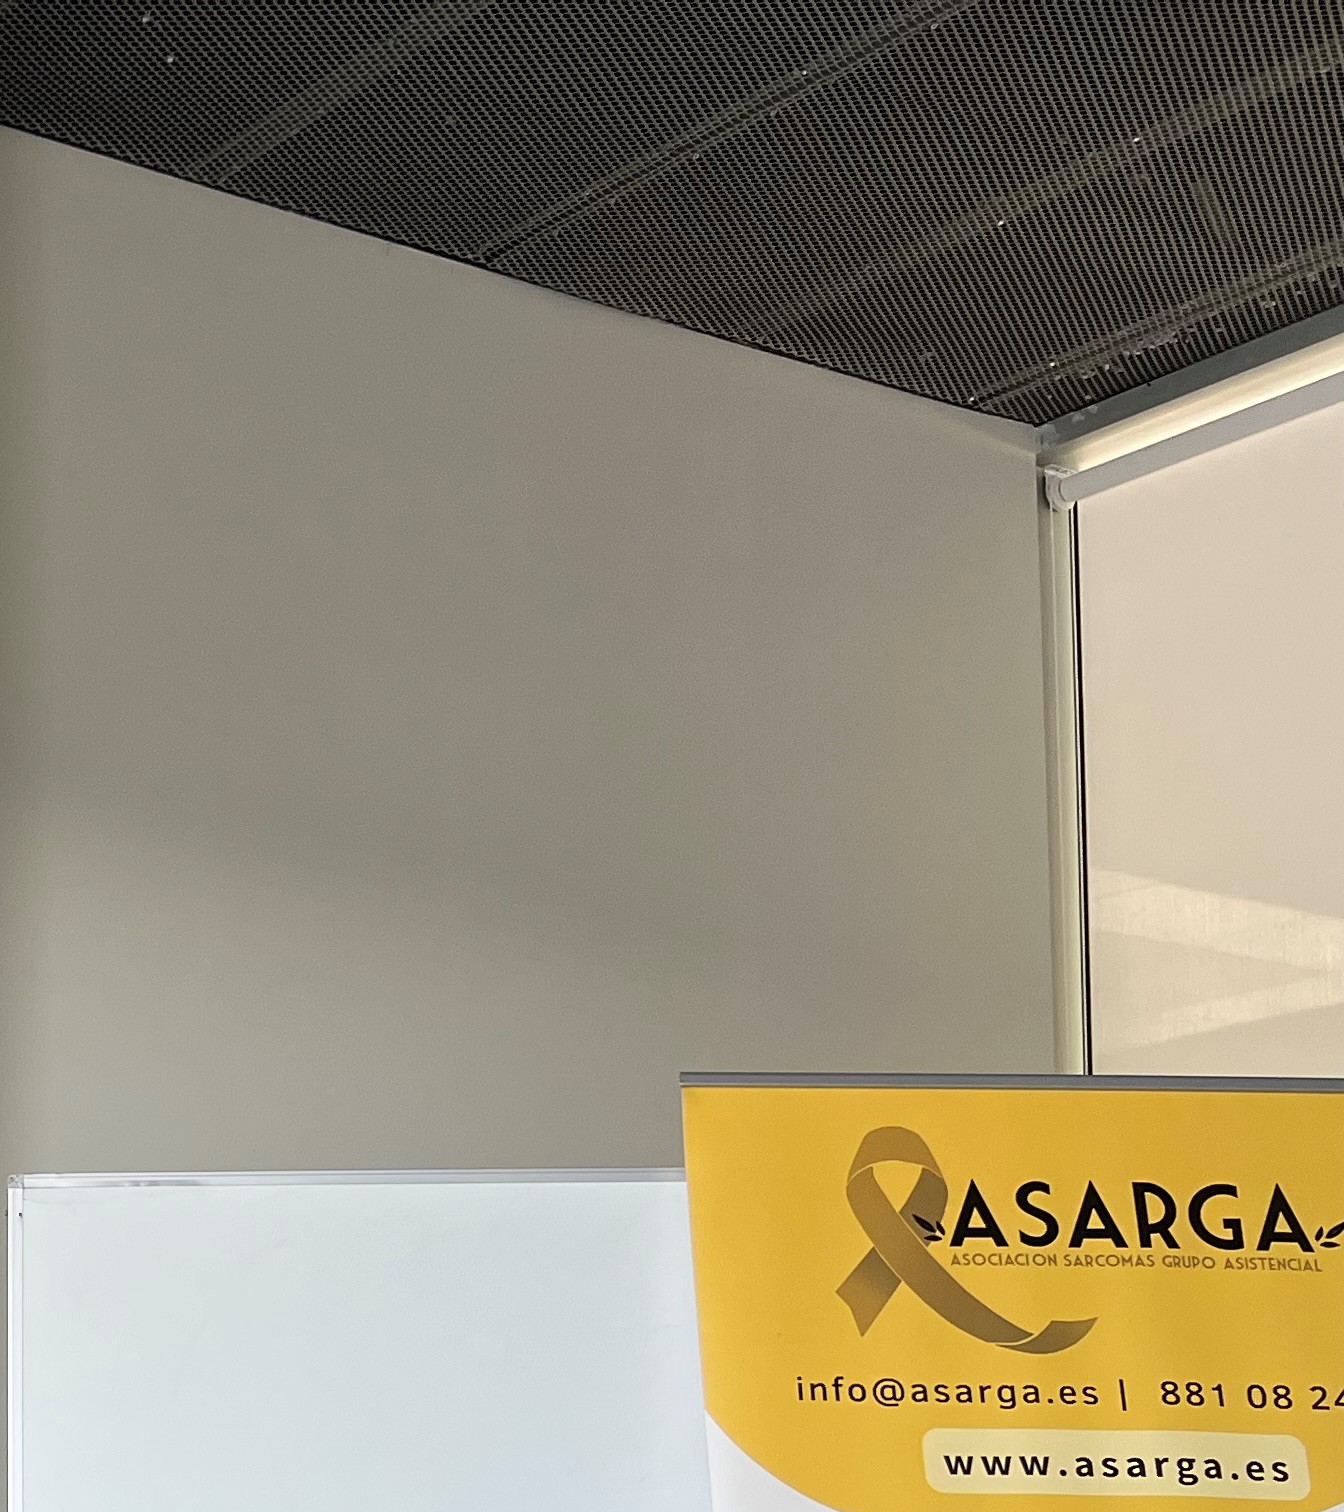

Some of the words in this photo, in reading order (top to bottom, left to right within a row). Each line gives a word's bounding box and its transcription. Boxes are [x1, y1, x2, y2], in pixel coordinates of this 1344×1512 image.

[950, 1179, 1315, 1253] ASARGA
[951, 1252, 1057, 1268] ASOCIACION
[1063, 1253, 1155, 1269] SARCOMAS
[1162, 1255, 1216, 1270] GRUPO
[1224, 1256, 1323, 1273] ASISTENCIAL
[796, 1375, 1099, 1409] info@asarga.es
[1161, 1381, 1225, 1408] 881
[1247, 1383, 1293, 1410] 08
[944, 1452, 1290, 1485] www.asarga.es
